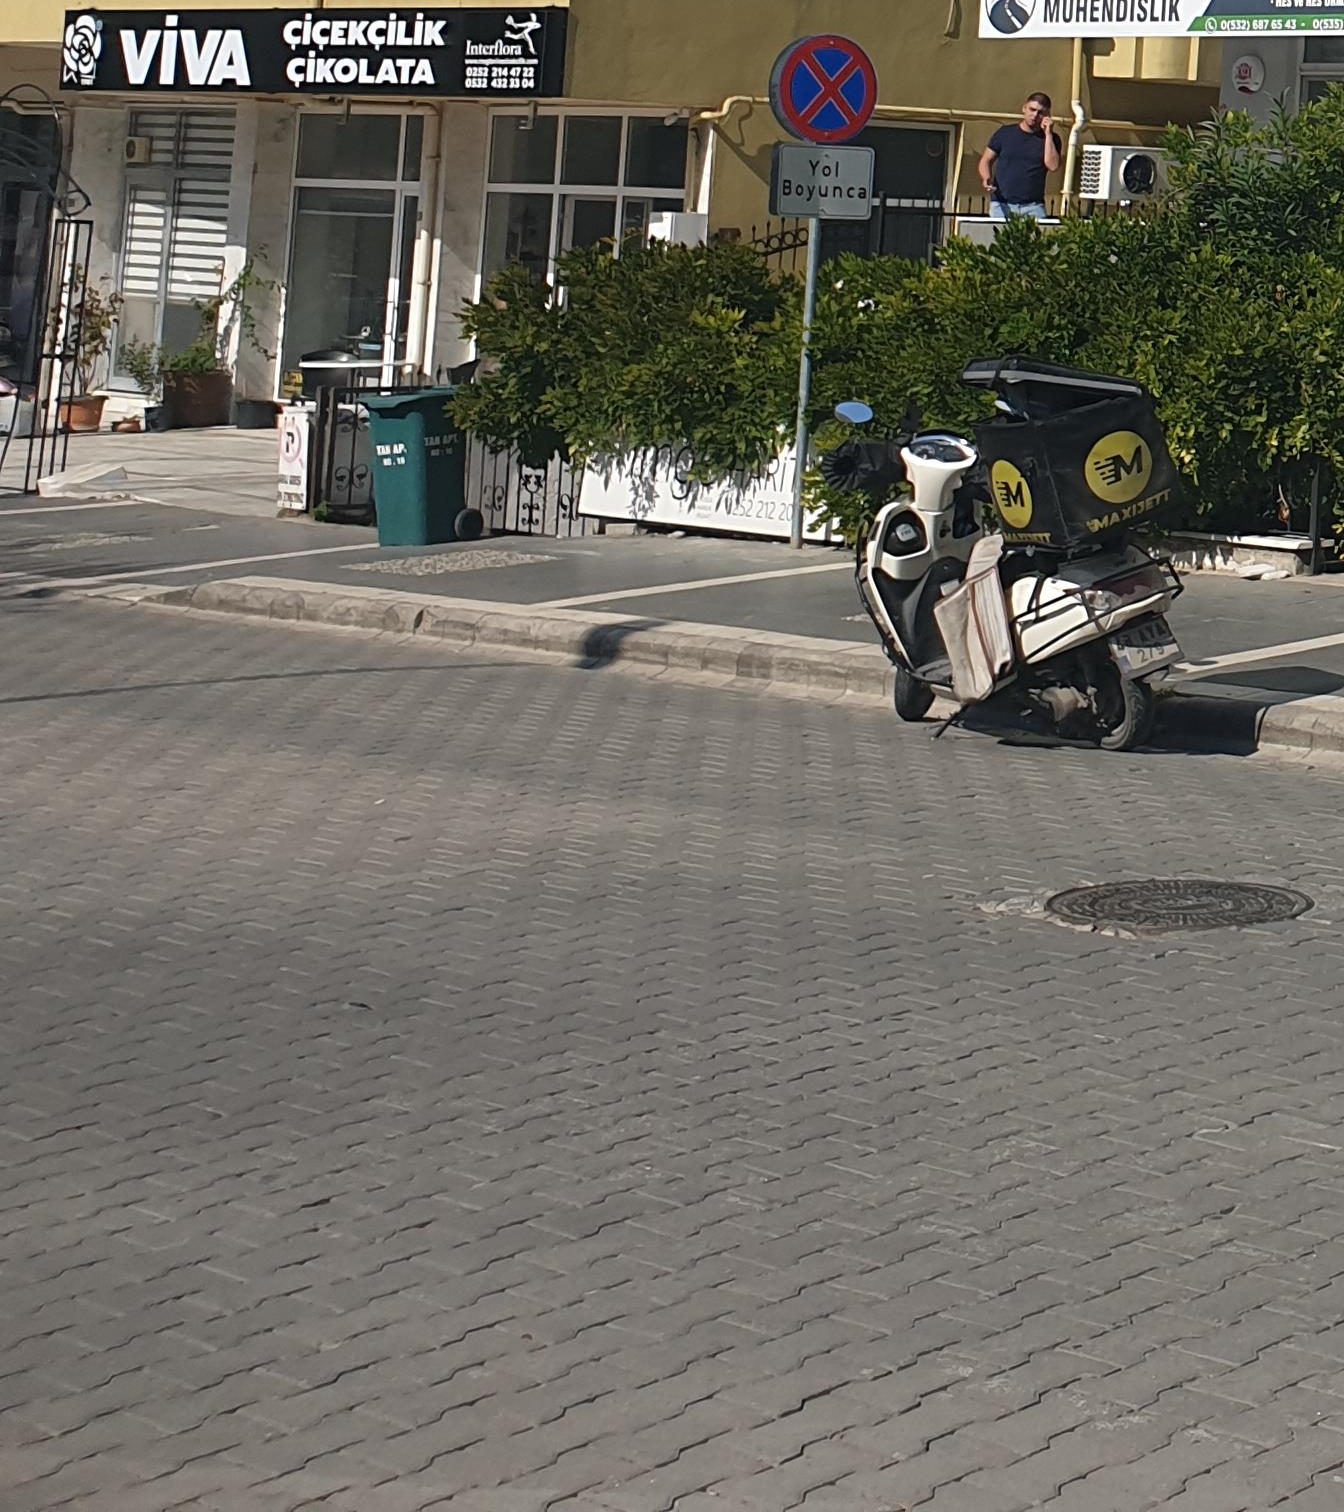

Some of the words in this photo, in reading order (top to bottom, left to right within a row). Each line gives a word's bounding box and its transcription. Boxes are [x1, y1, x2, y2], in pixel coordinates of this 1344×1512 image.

[1294, 0, 1304, 8] ve
[282, 13, 447, 51] ÇİÇEKÇİLİK
[1220, 18, 1250, 31] 0(532)
[1252, 18, 1269, 31] 687
[1271, 18, 1283, 30] 65
[1284, 18, 1297, 30] 43
[1312, 17, 1344, 31] 0(535)
[119, 14, 251, 86] VİVA
[465, 39, 522, 56] Interflora
[286, 50, 436, 88] ÇİKOLATA
[465, 67, 489, 77] 0252
[491, 67, 508, 77] 214
[509, 67, 521, 77] 47
[522, 67, 534, 77] 22
[465, 78, 488, 88] 0532
[521, 78, 534, 88] 04
[809, 160, 839, 178] Yol
[783, 180, 867, 202] Boyunca
[756, 501, 776, 520] 212
